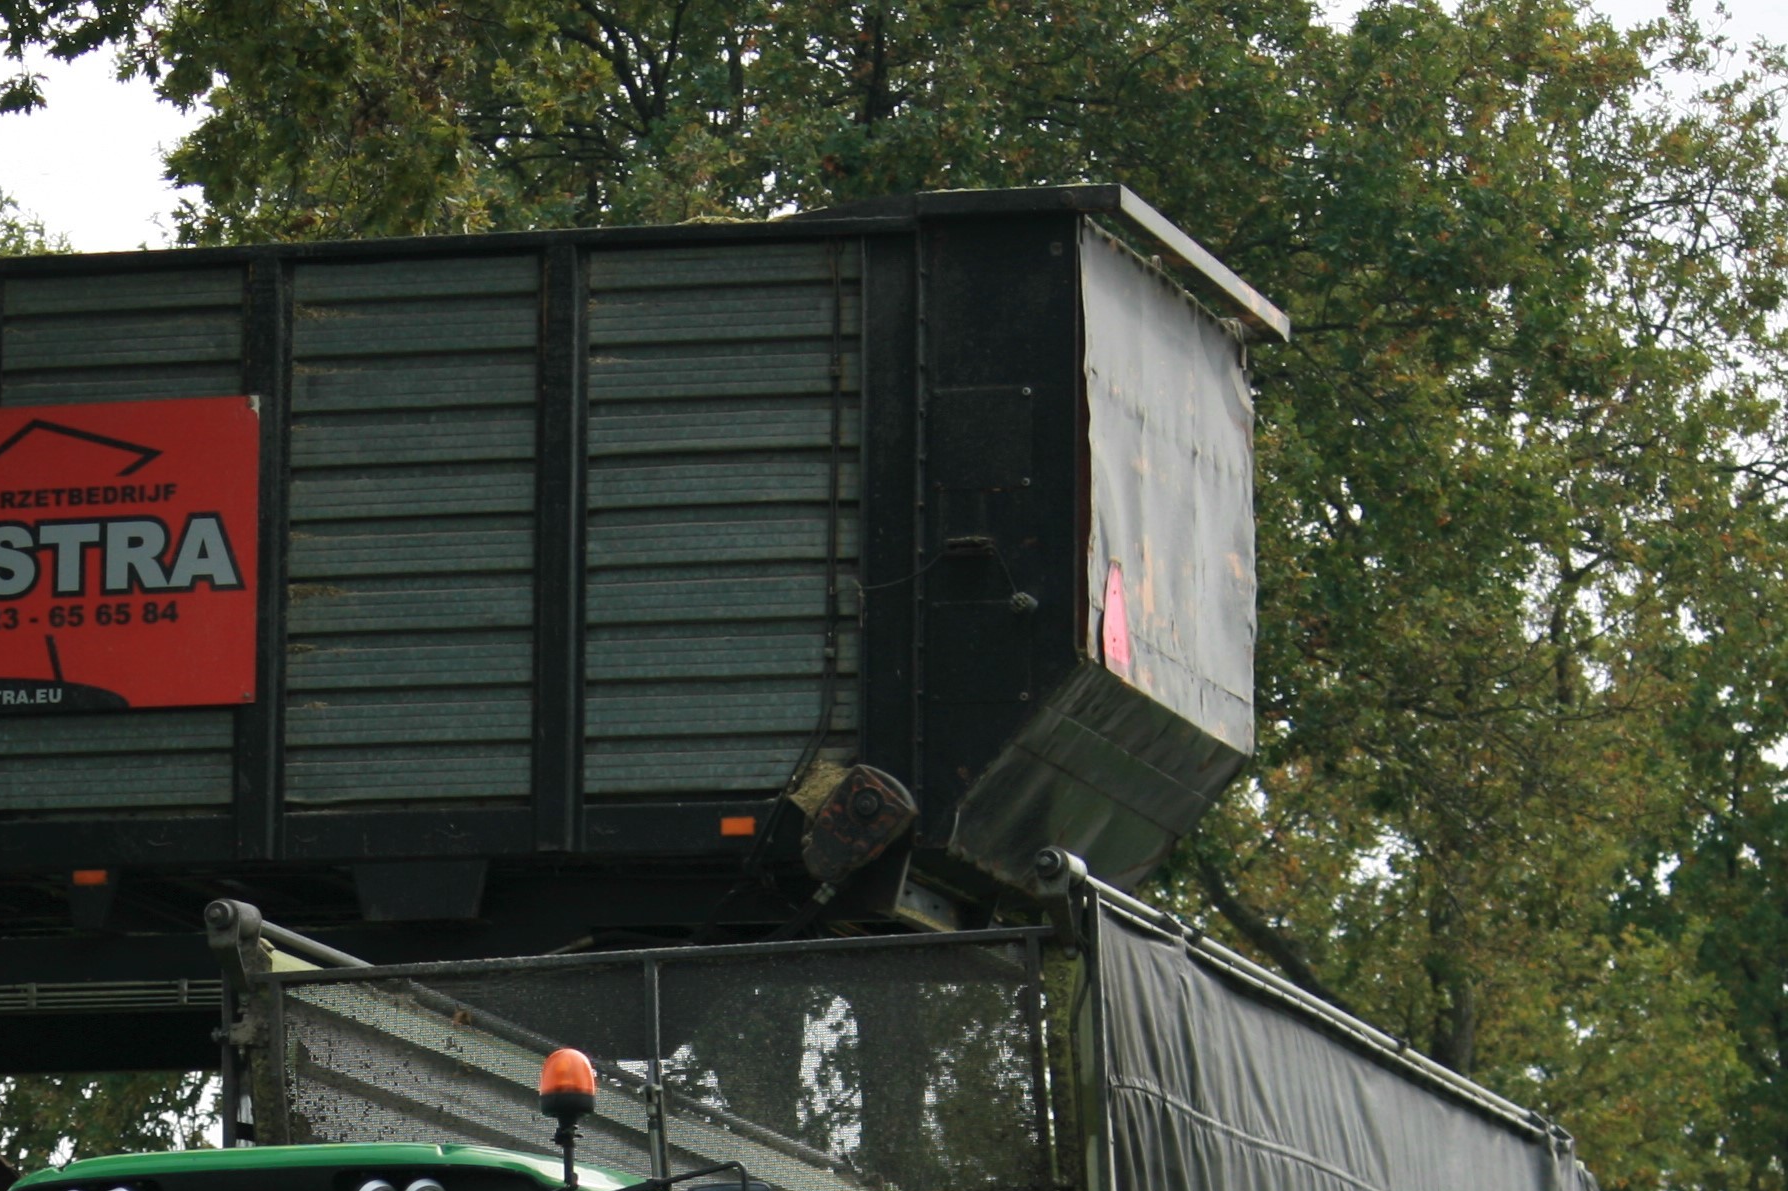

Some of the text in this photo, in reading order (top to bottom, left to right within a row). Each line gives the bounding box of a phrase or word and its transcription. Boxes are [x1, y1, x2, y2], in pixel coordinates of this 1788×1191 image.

[49, 605, 84, 627] 65
[96, 603, 131, 625] 65
[142, 600, 179, 624] 84
